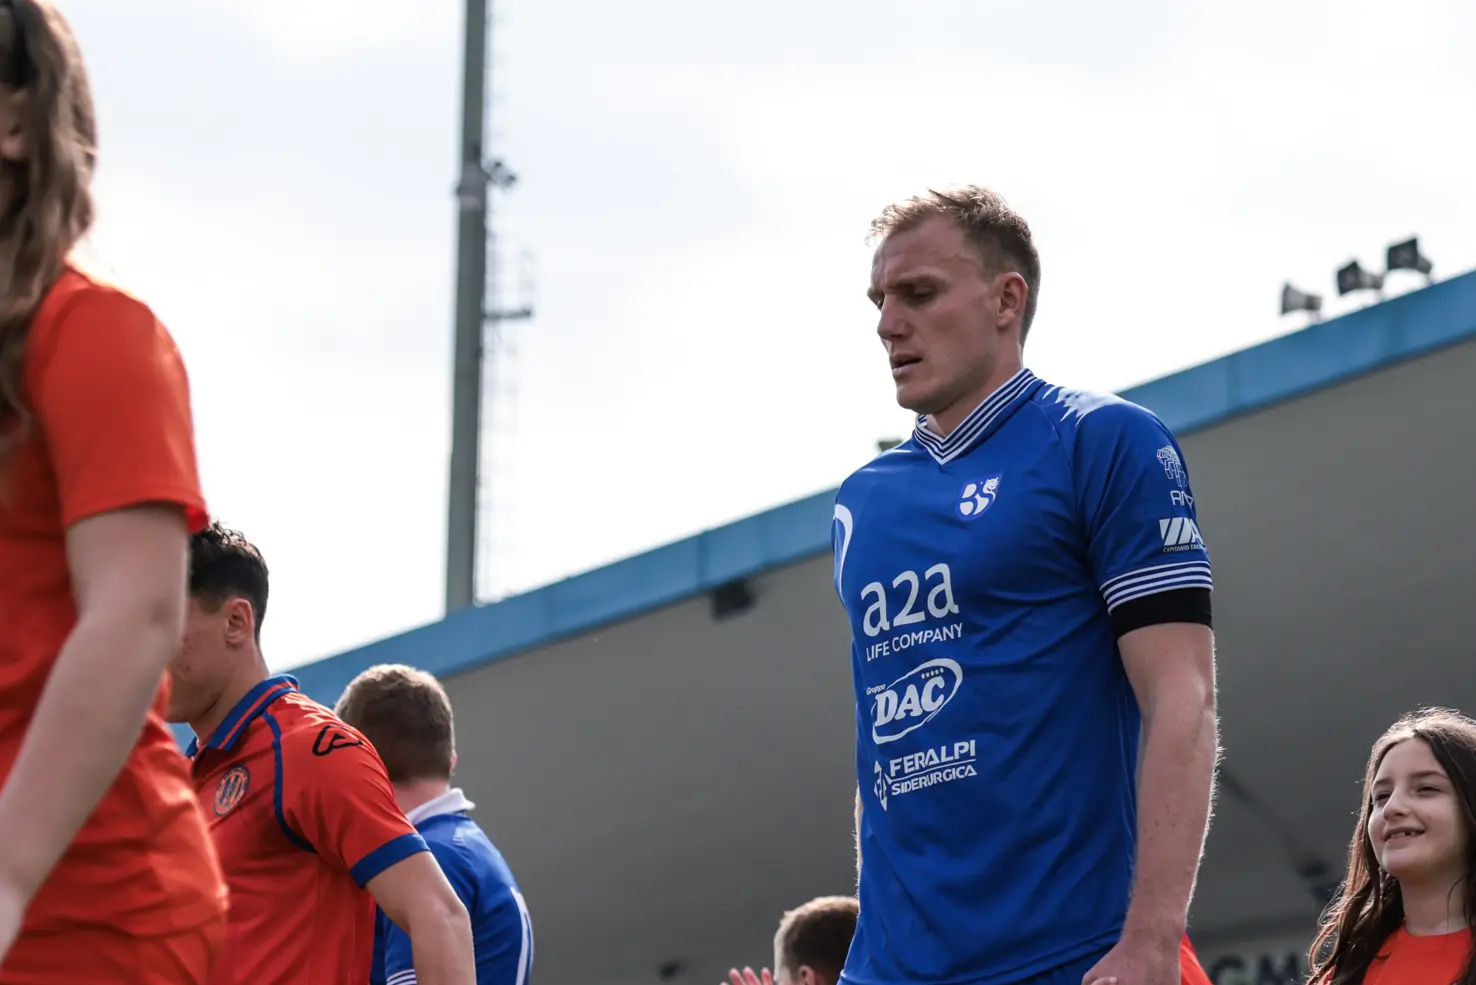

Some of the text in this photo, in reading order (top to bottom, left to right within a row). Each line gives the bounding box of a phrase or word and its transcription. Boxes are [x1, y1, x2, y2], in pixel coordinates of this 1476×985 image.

[861, 563, 959, 637] a2a
[866, 623, 962, 662] LIFE COMPANY
[874, 676, 945, 727] DAC
[890, 740, 976, 777] FERALPI
[891, 764, 977, 795] SIDERURGICA
